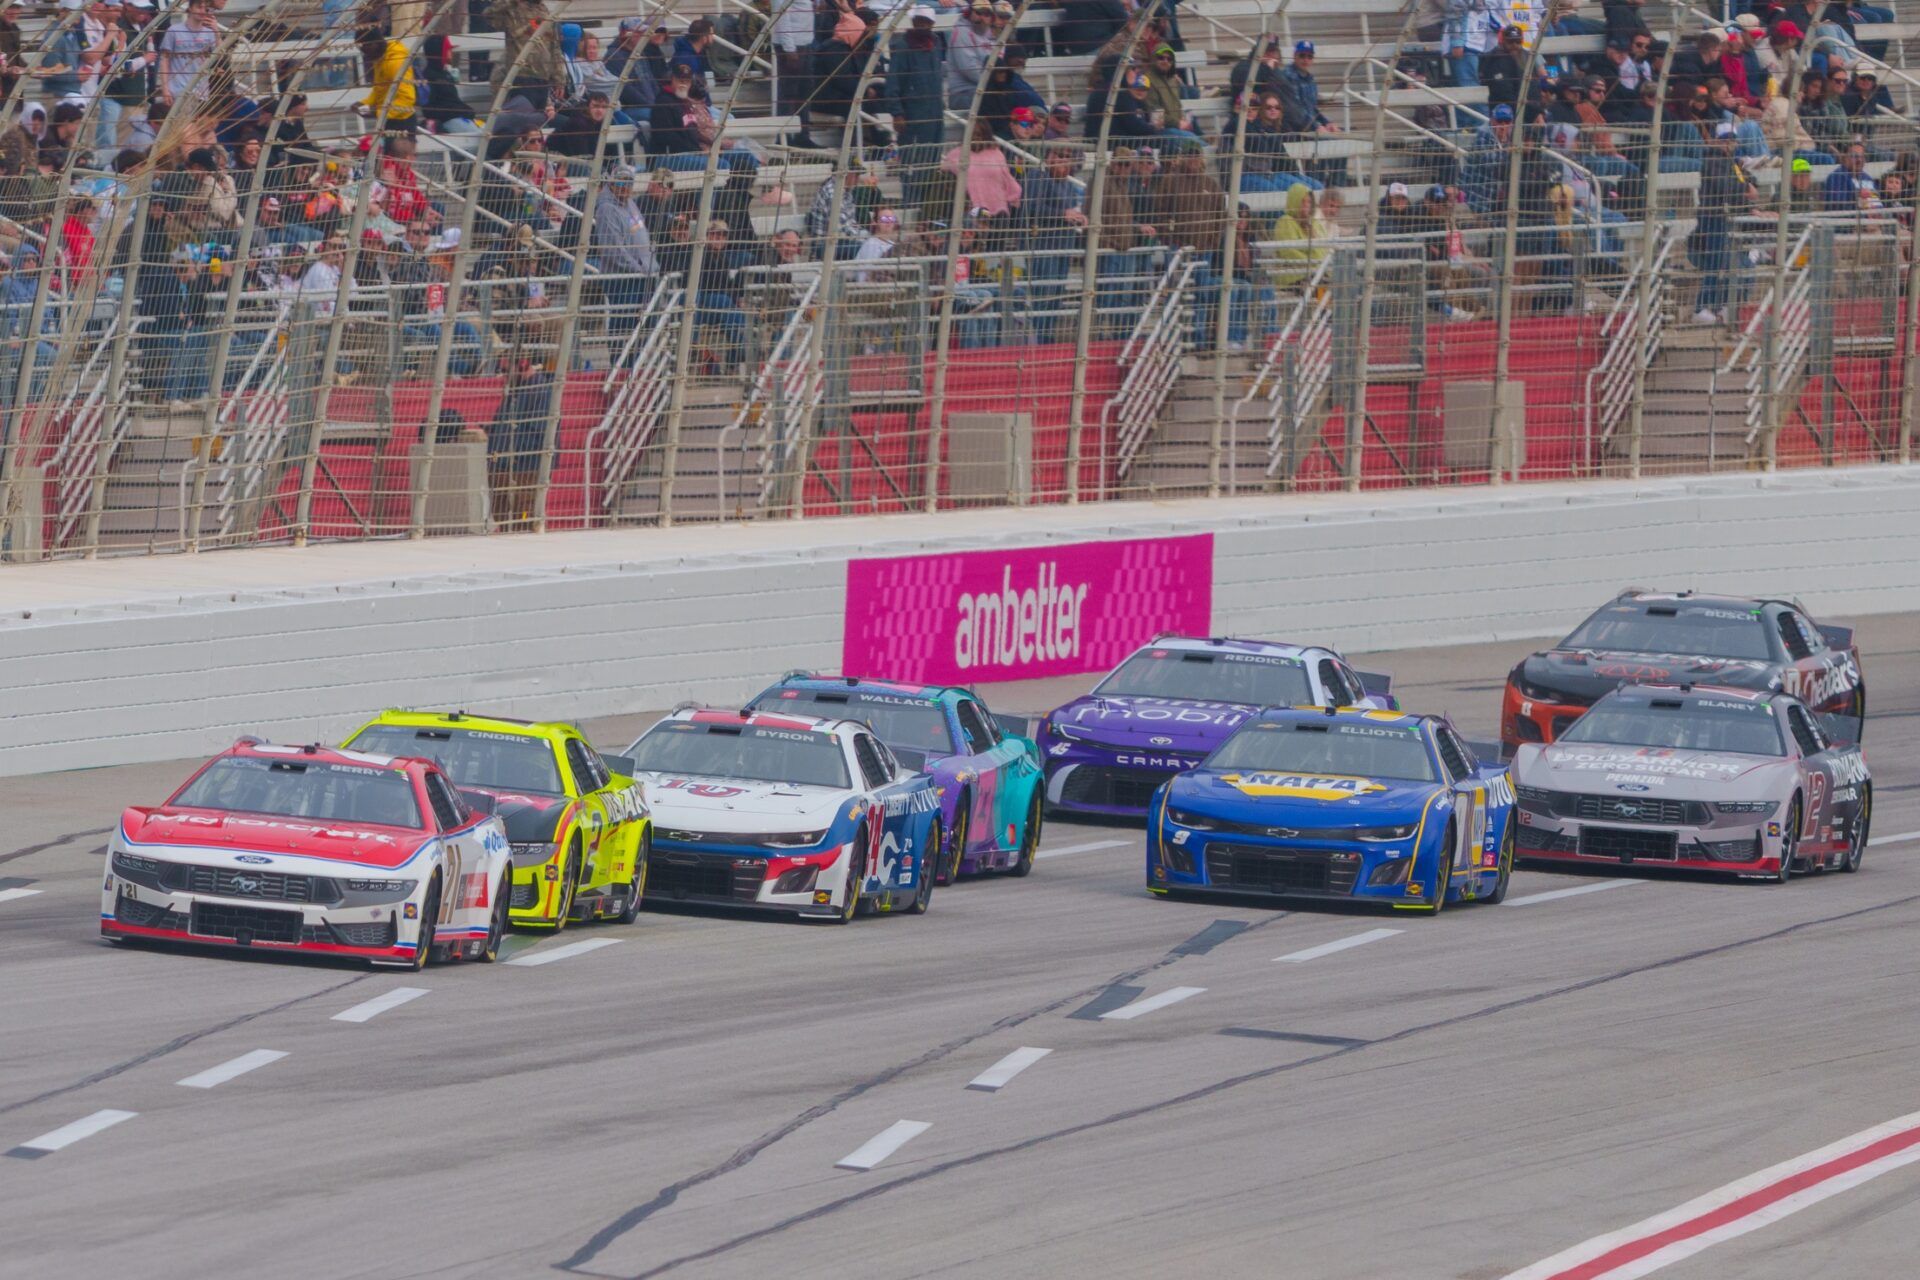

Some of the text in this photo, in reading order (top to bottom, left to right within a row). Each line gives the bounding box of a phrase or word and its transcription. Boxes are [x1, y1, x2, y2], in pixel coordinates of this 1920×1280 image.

[956, 562, 1087, 669] ambetter
[1704, 610, 1758, 621] BUSCH
[1224, 653, 1290, 666] REDDICK
[860, 693, 934, 708] WALLACE
[1697, 700, 1757, 711] BLANEY
[467, 730, 531, 744] CINDRIC
[755, 729, 815, 743] BYRON
[1340, 725, 1407, 739] ELLIOTT
[1116, 755, 1200, 769] CAMRY
[1552, 751, 1740, 775] BODYARMOR
[330, 764, 385, 777] BERRY
[1575, 762, 1706, 779] ZERO SUGAR
[1248, 773, 1358, 791] NAPA
[1605, 773, 1666, 786] PENNZOIL
[1804, 771, 1827, 840] 12
[1519, 811, 1532, 825] 12
[148, 813, 395, 847] Motorcraft
[1172, 830, 1191, 845] 9
[125, 883, 138, 899] 21
